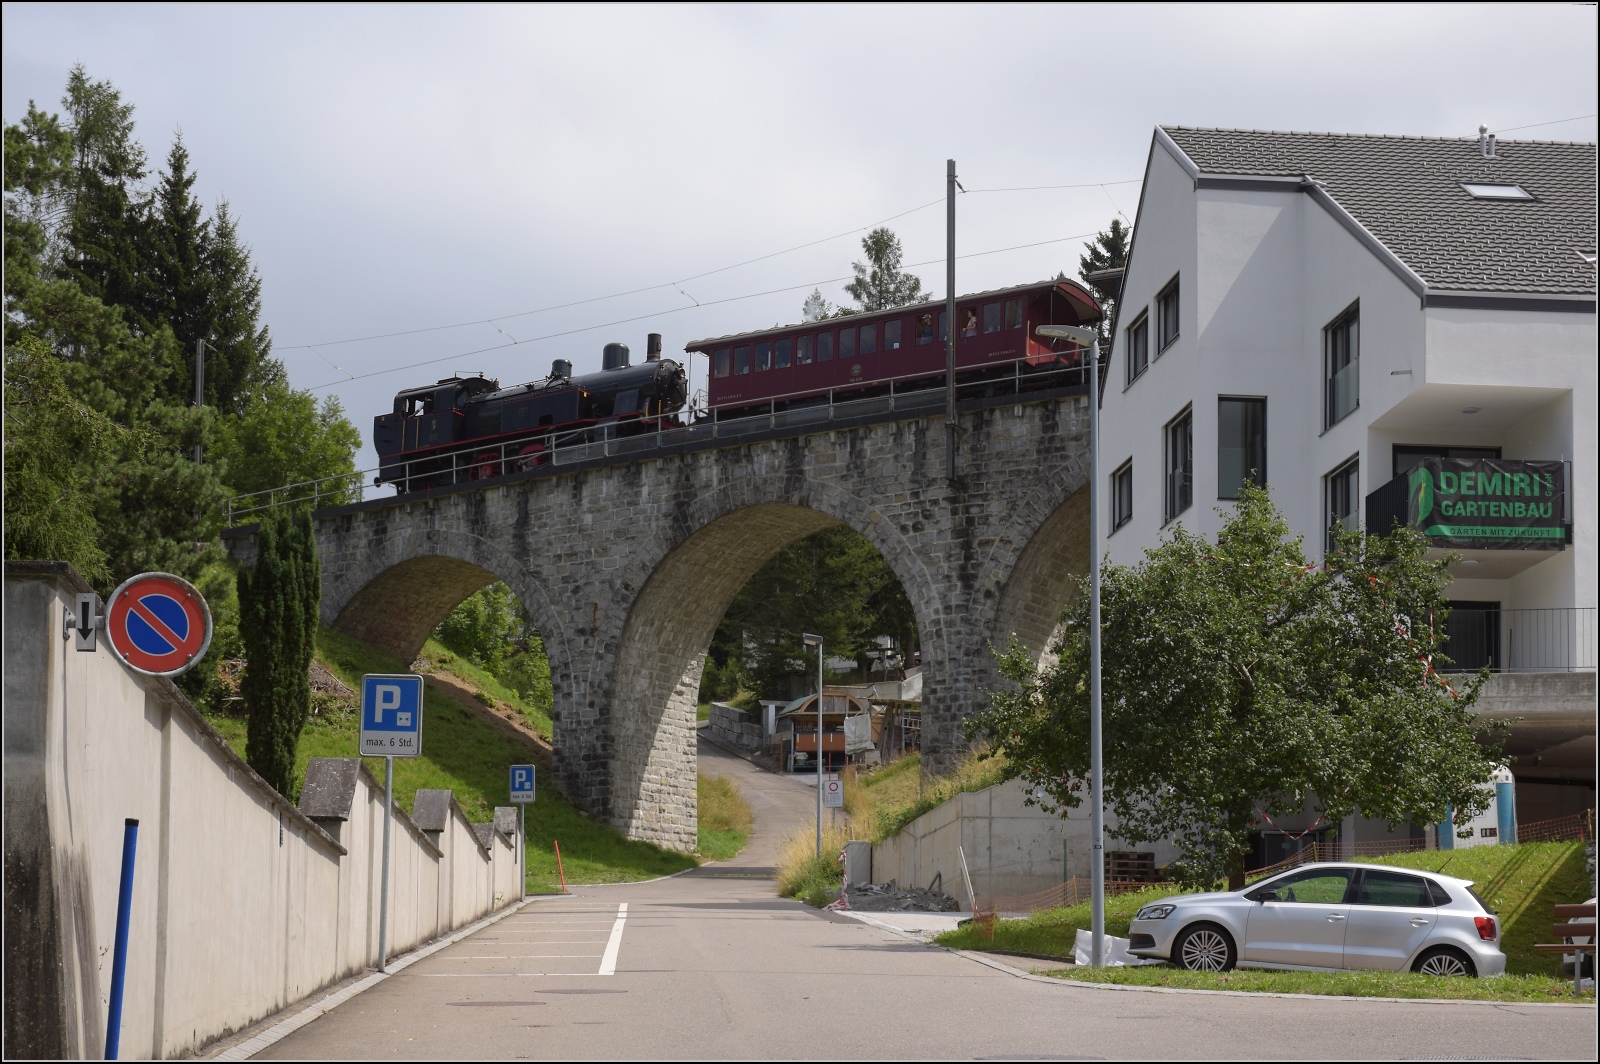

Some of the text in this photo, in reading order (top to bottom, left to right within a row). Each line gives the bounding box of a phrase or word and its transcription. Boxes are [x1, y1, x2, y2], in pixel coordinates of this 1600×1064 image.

[1440, 471, 1539, 497] DEMIRI
[1441, 500, 1553, 518] GARTENBAU
[1490, 528, 1506, 536] MIT
[1508, 529, 1552, 537] ZUKUNFT
[374, 685, 401, 723] P
[366, 737, 414, 747] max. 6 Std.
[515, 769, 526, 788] P
